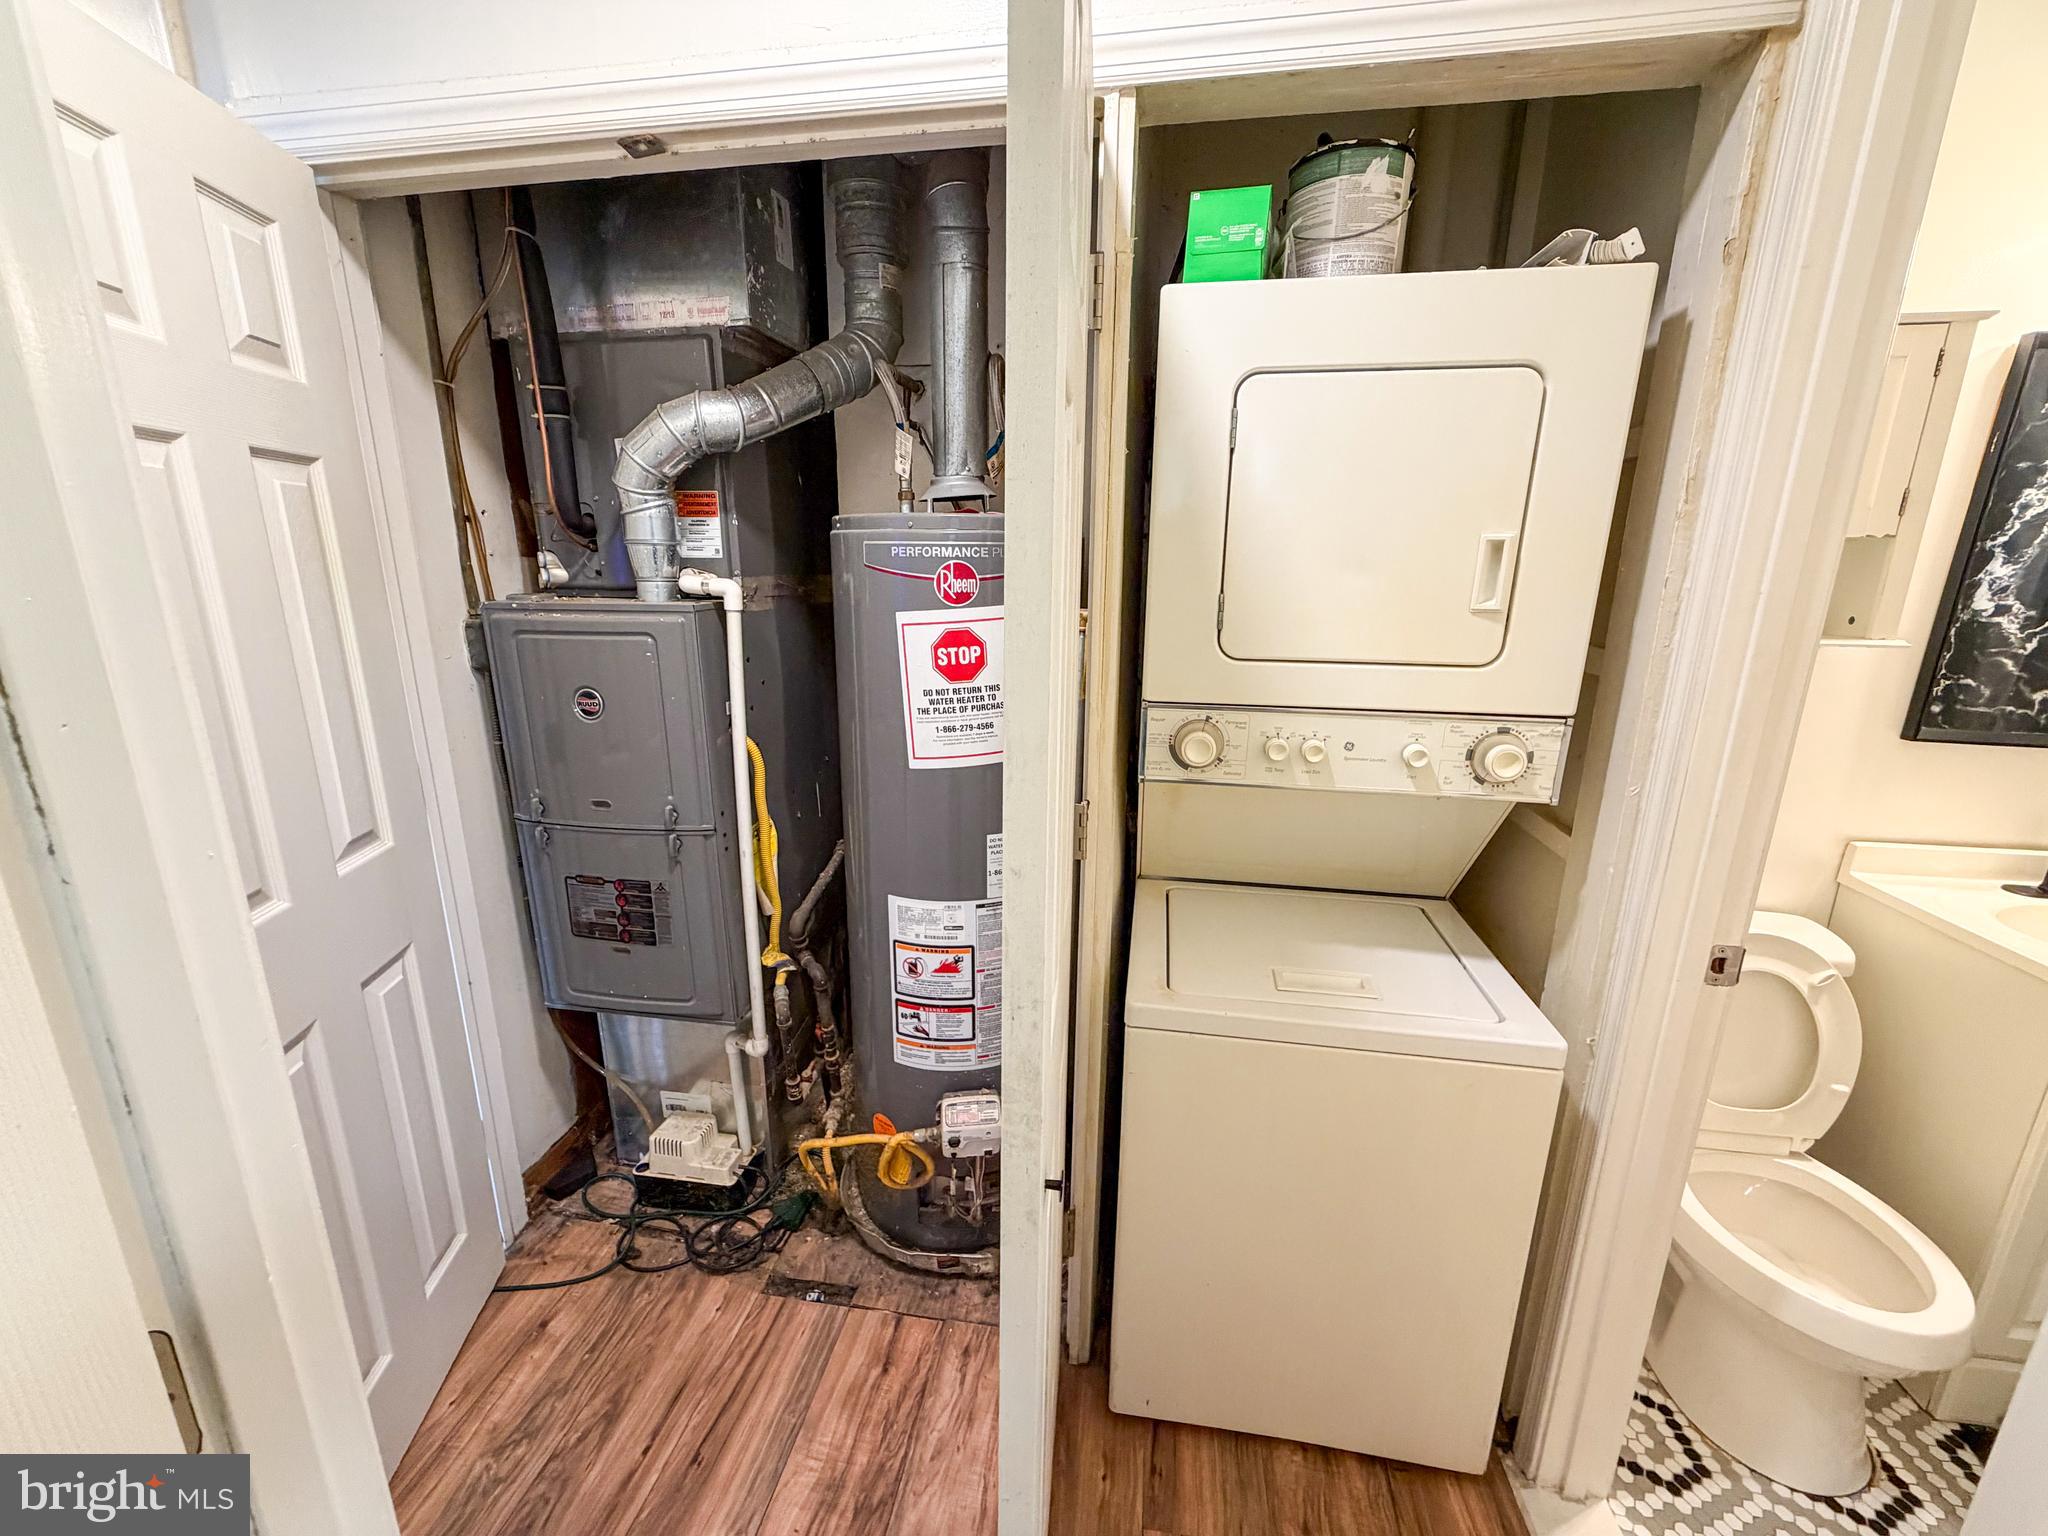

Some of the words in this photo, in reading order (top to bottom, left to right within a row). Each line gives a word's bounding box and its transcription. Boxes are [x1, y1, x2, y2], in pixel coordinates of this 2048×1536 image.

[891, 546, 989, 558] PERFORMANCE
[992, 546, 1004, 558] PL
[940, 561, 976, 599] Rheem
[937, 645, 981, 666] STOP
[923, 689, 933, 697] DO
[935, 688, 950, 696] NOT
[952, 686, 982, 696] RETURN
[984, 684, 1001, 693] THIS
[928, 697, 955, 706] WATER
[956, 694, 985, 705] HEATER
[987, 693, 997, 701] TO
[917, 707, 931, 715] THE
[933, 706, 957, 715] PLACE
[959, 705, 969, 713] OF
[971, 701, 1004, 712] PURCHAS
[936, 721, 994, 733] 1-866-279-4566
